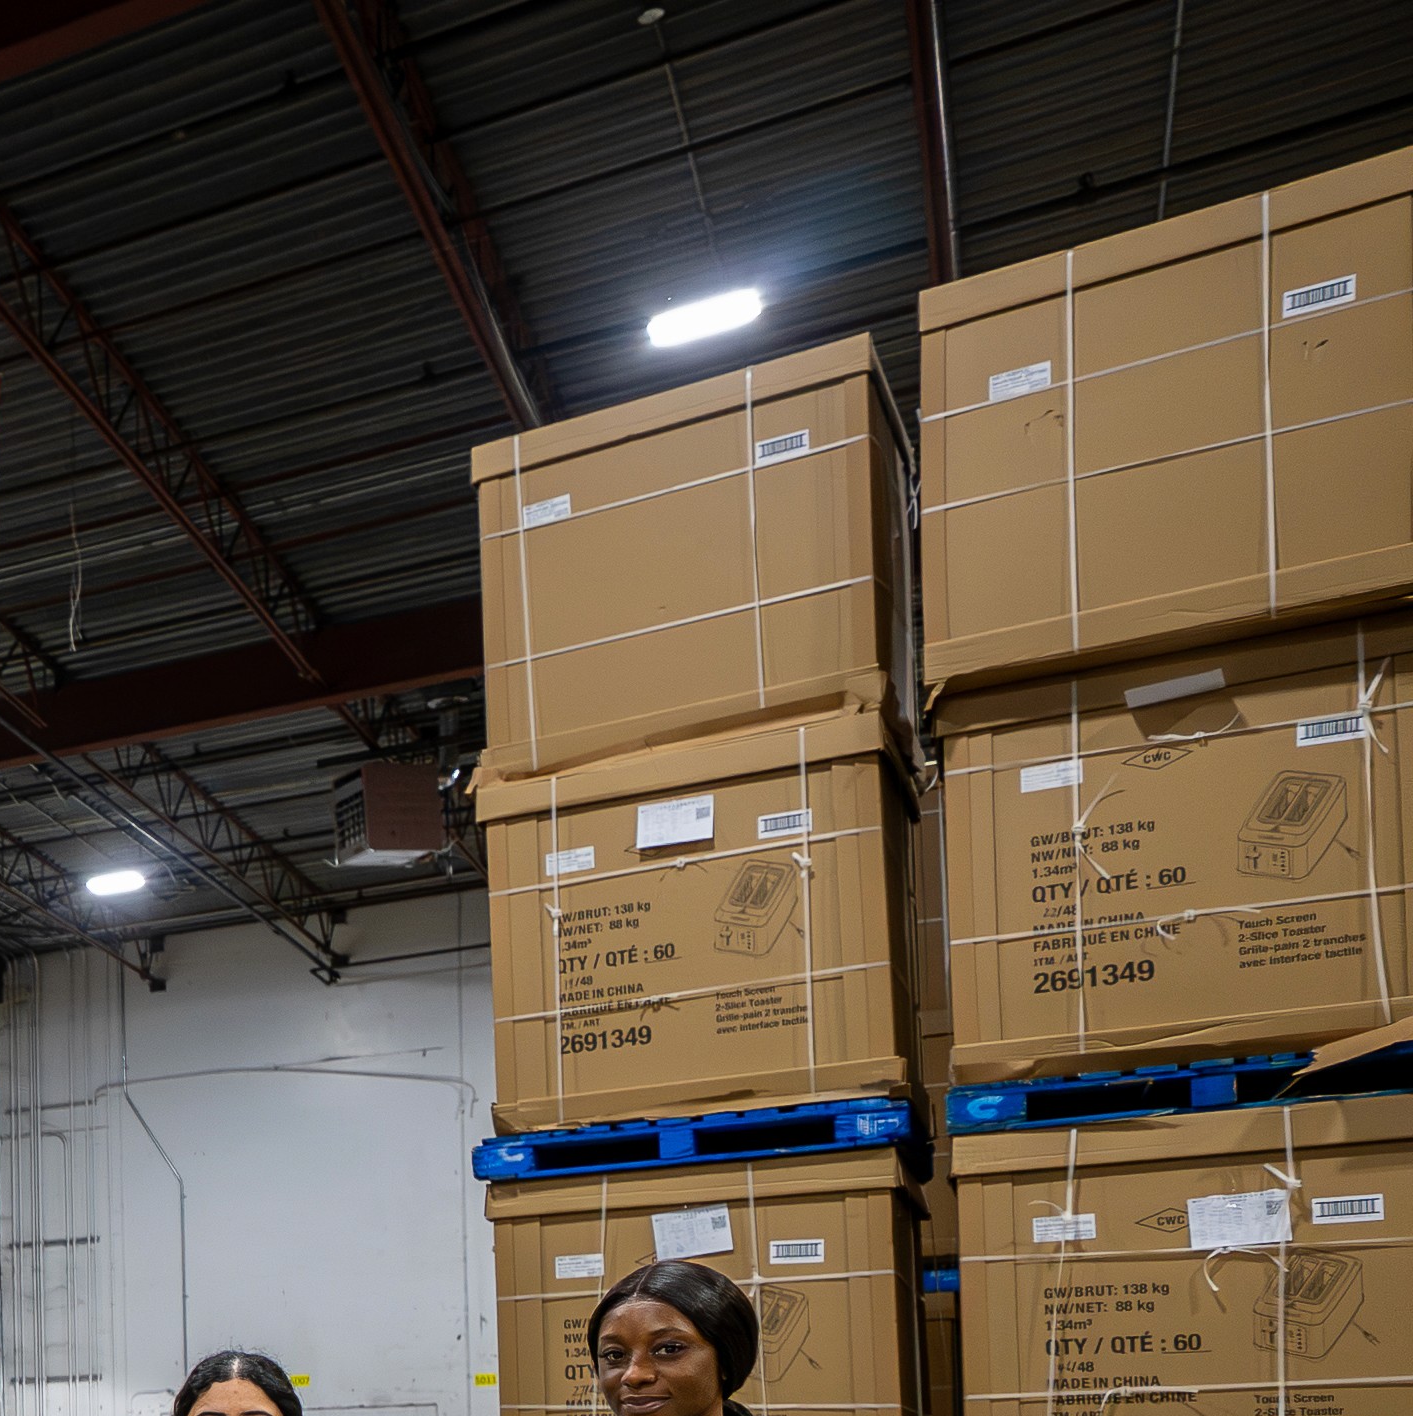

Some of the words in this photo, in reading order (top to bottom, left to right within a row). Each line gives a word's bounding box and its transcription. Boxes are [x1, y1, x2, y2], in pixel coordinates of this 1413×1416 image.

[1031, 826, 1104, 847] GW/BUT:
[1109, 822, 1133, 835] 138
[1138, 820, 1155, 832] kg
[1101, 840, 1118, 852] 88
[1123, 838, 1140, 850] kg
[1033, 882, 1073, 903] QTY
[1097, 869, 1138, 894] QTÉ
[1159, 866, 1186, 885] 60
[559, 906, 611, 924] W/BRUT:
[637, 902, 651, 912] kg
[609, 919, 623, 930] 88
[626, 918, 639, 929] kg
[1238, 918, 1273, 930] Touch
[1276, 913, 1316, 925] Screen
[1111, 930, 1130, 942] EN
[1238, 930, 1278, 943] 2-Slice
[1282, 925, 1326, 937] Toaster
[1313, 933, 1366, 946] tranches
[606, 945, 638, 967] QTÉ
[654, 943, 675, 960] 60
[1239, 958, 1266, 969] avec
[1269, 952, 1321, 965] interface
[1325, 946, 1362, 959] tactile
[1033, 960, 1155, 994] 2691349
[593, 988, 604, 999] IN
[607, 984, 644, 997] CHINA
[773, 1004, 808, 1015] tranche
[561, 1025, 652, 1054] 2691349
[1157, 1215, 1185, 1226] CWC
[1044, 1285, 1118, 1299] GW/BRUT:
[1123, 1284, 1148, 1295] 138
[1153, 1283, 1169, 1295] kg
[1045, 1302, 1107, 1315] NW/NET:
[1115, 1301, 1132, 1312] 88
[1137, 1300, 1155, 1313] kg
[1045, 1338, 1087, 1356] QTY
[1111, 1331, 1153, 1354] QTÉ
[1173, 1334, 1201, 1351] 60
[1094, 1377, 1108, 1388] IN
[1113, 1376, 1161, 1387] CHINA
[1293, 1394, 1334, 1403] Screen
[1299, 1407, 1344, 1416] Toaster
